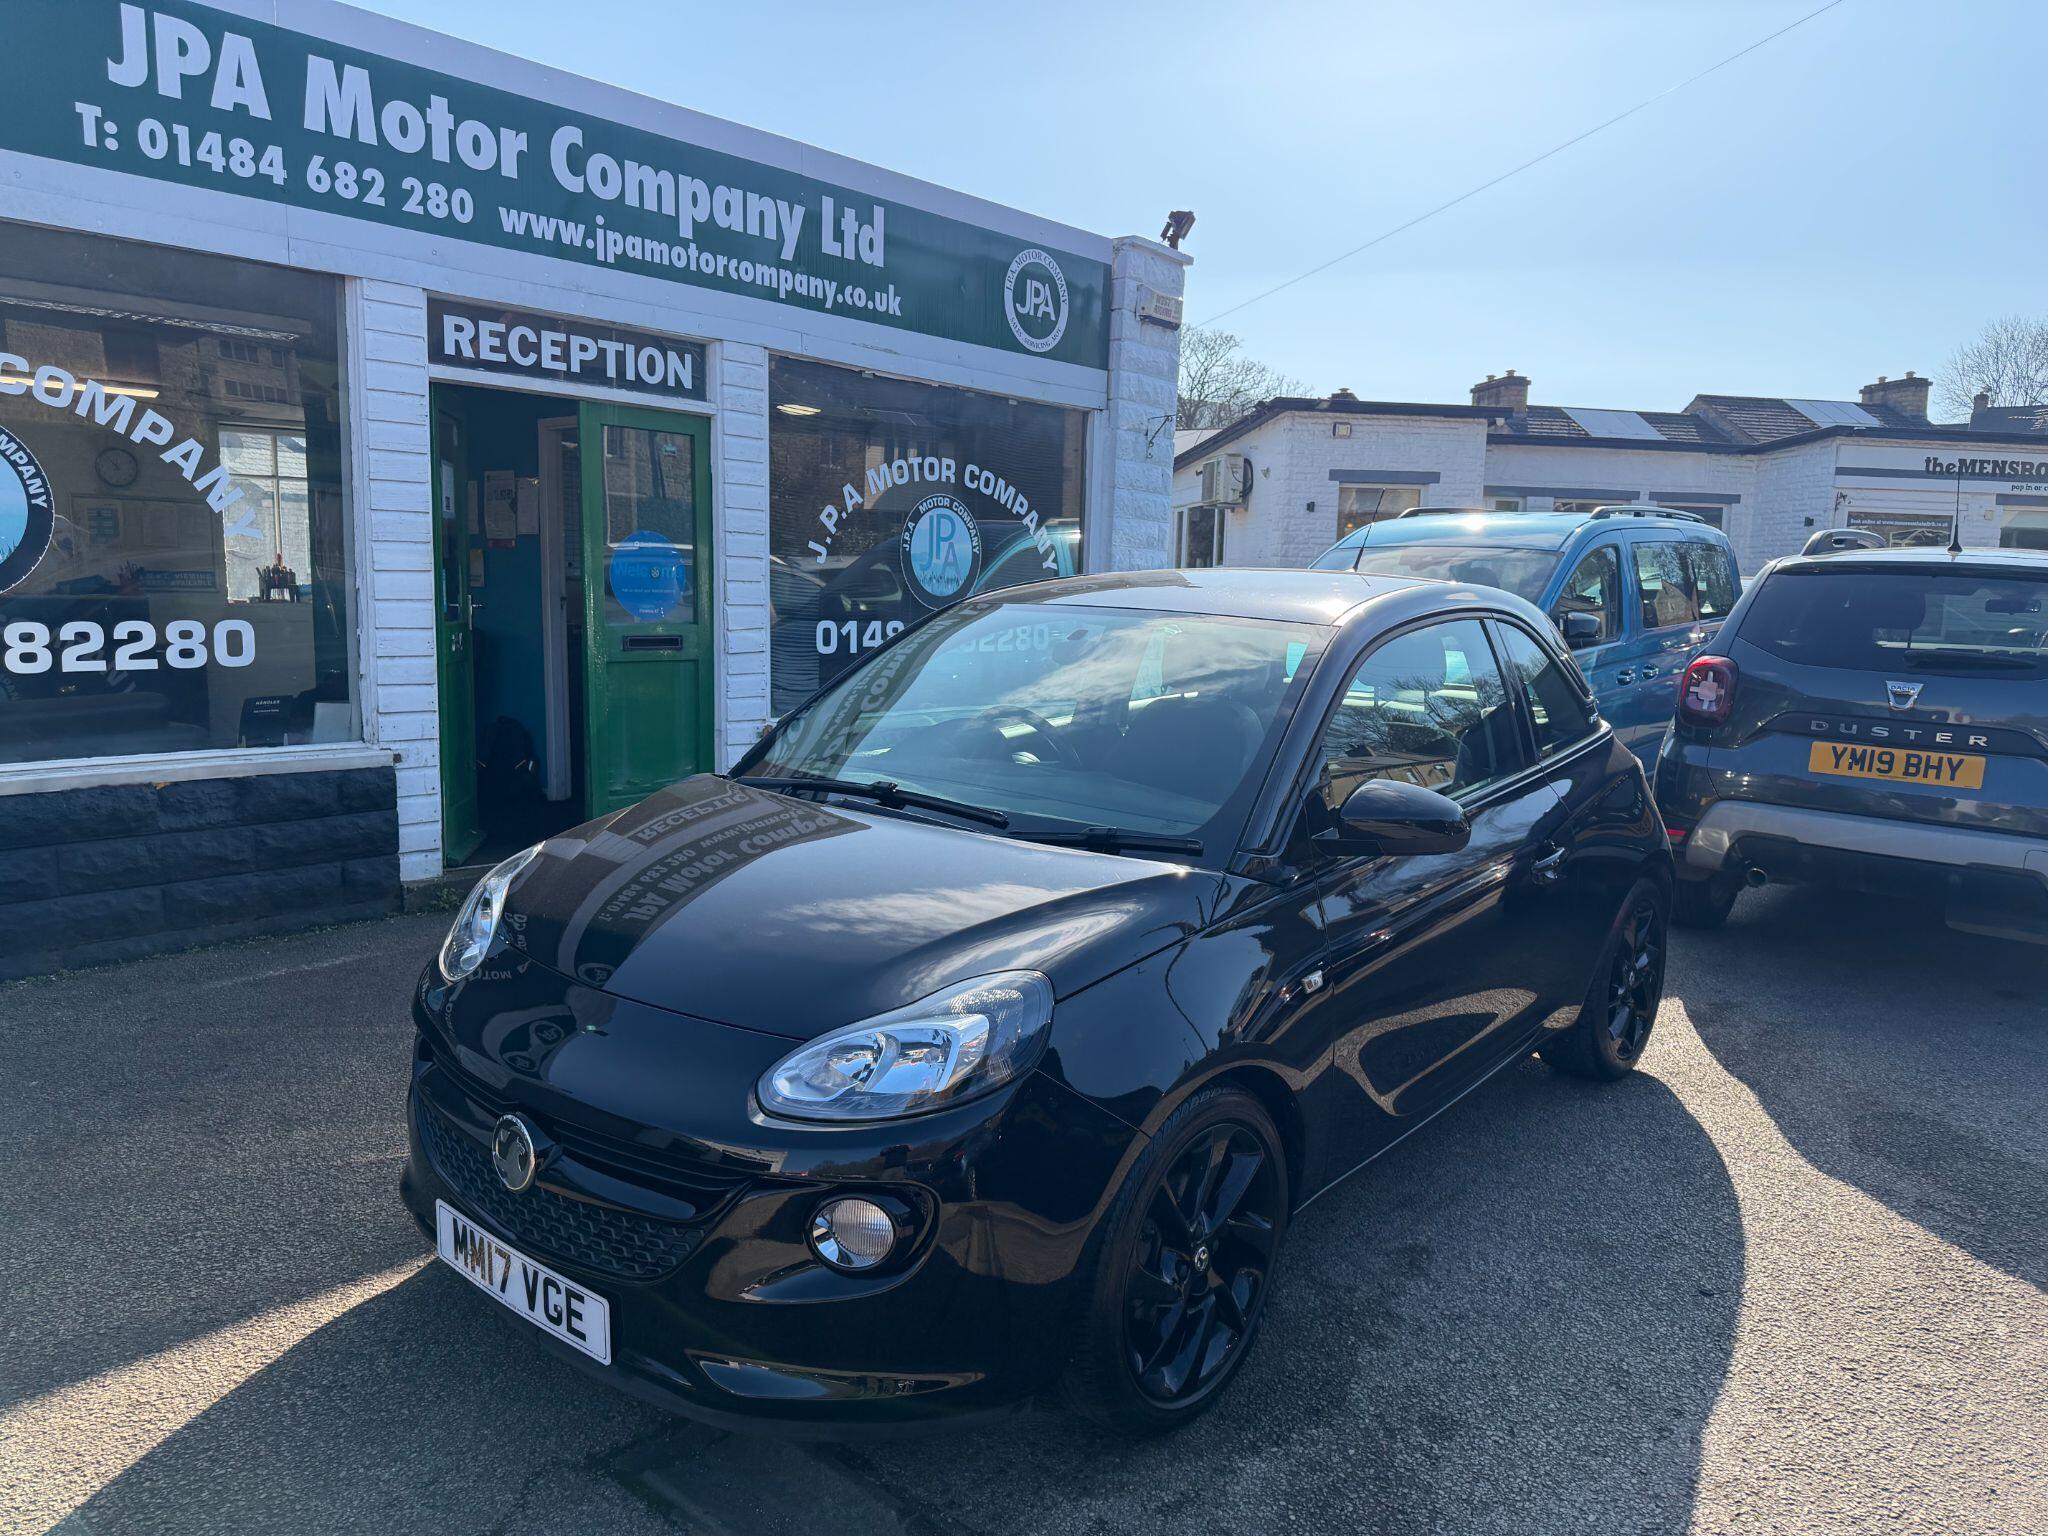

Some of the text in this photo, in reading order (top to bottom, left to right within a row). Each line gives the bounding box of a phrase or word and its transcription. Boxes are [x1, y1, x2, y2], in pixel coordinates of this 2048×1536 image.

[107, 3, 885, 267] JPA Motor Company Ltd
[75, 102, 902, 316] T: 01484 682 280 www.jpamotorcompany.co.uk
[1015, 250, 1043, 268] MOTOR
[1044, 256, 1067, 305] COMPANY
[1015, 279, 1056, 321] JPA
[443, 315, 693, 390] RECEPTION
[808, 456, 1058, 571] J.P.A MOTOR COMPANY
[2011, 484, 2025, 492] pop
[919, 497, 950, 514] MOTOR
[952, 503, 979, 554] COMPANY
[919, 513, 961, 579] JPA
[1810, 720, 1988, 747] DUSTER
[1831, 746, 1965, 781] YM19 BHY
[453, 1217, 587, 1342] MM17 VGE
